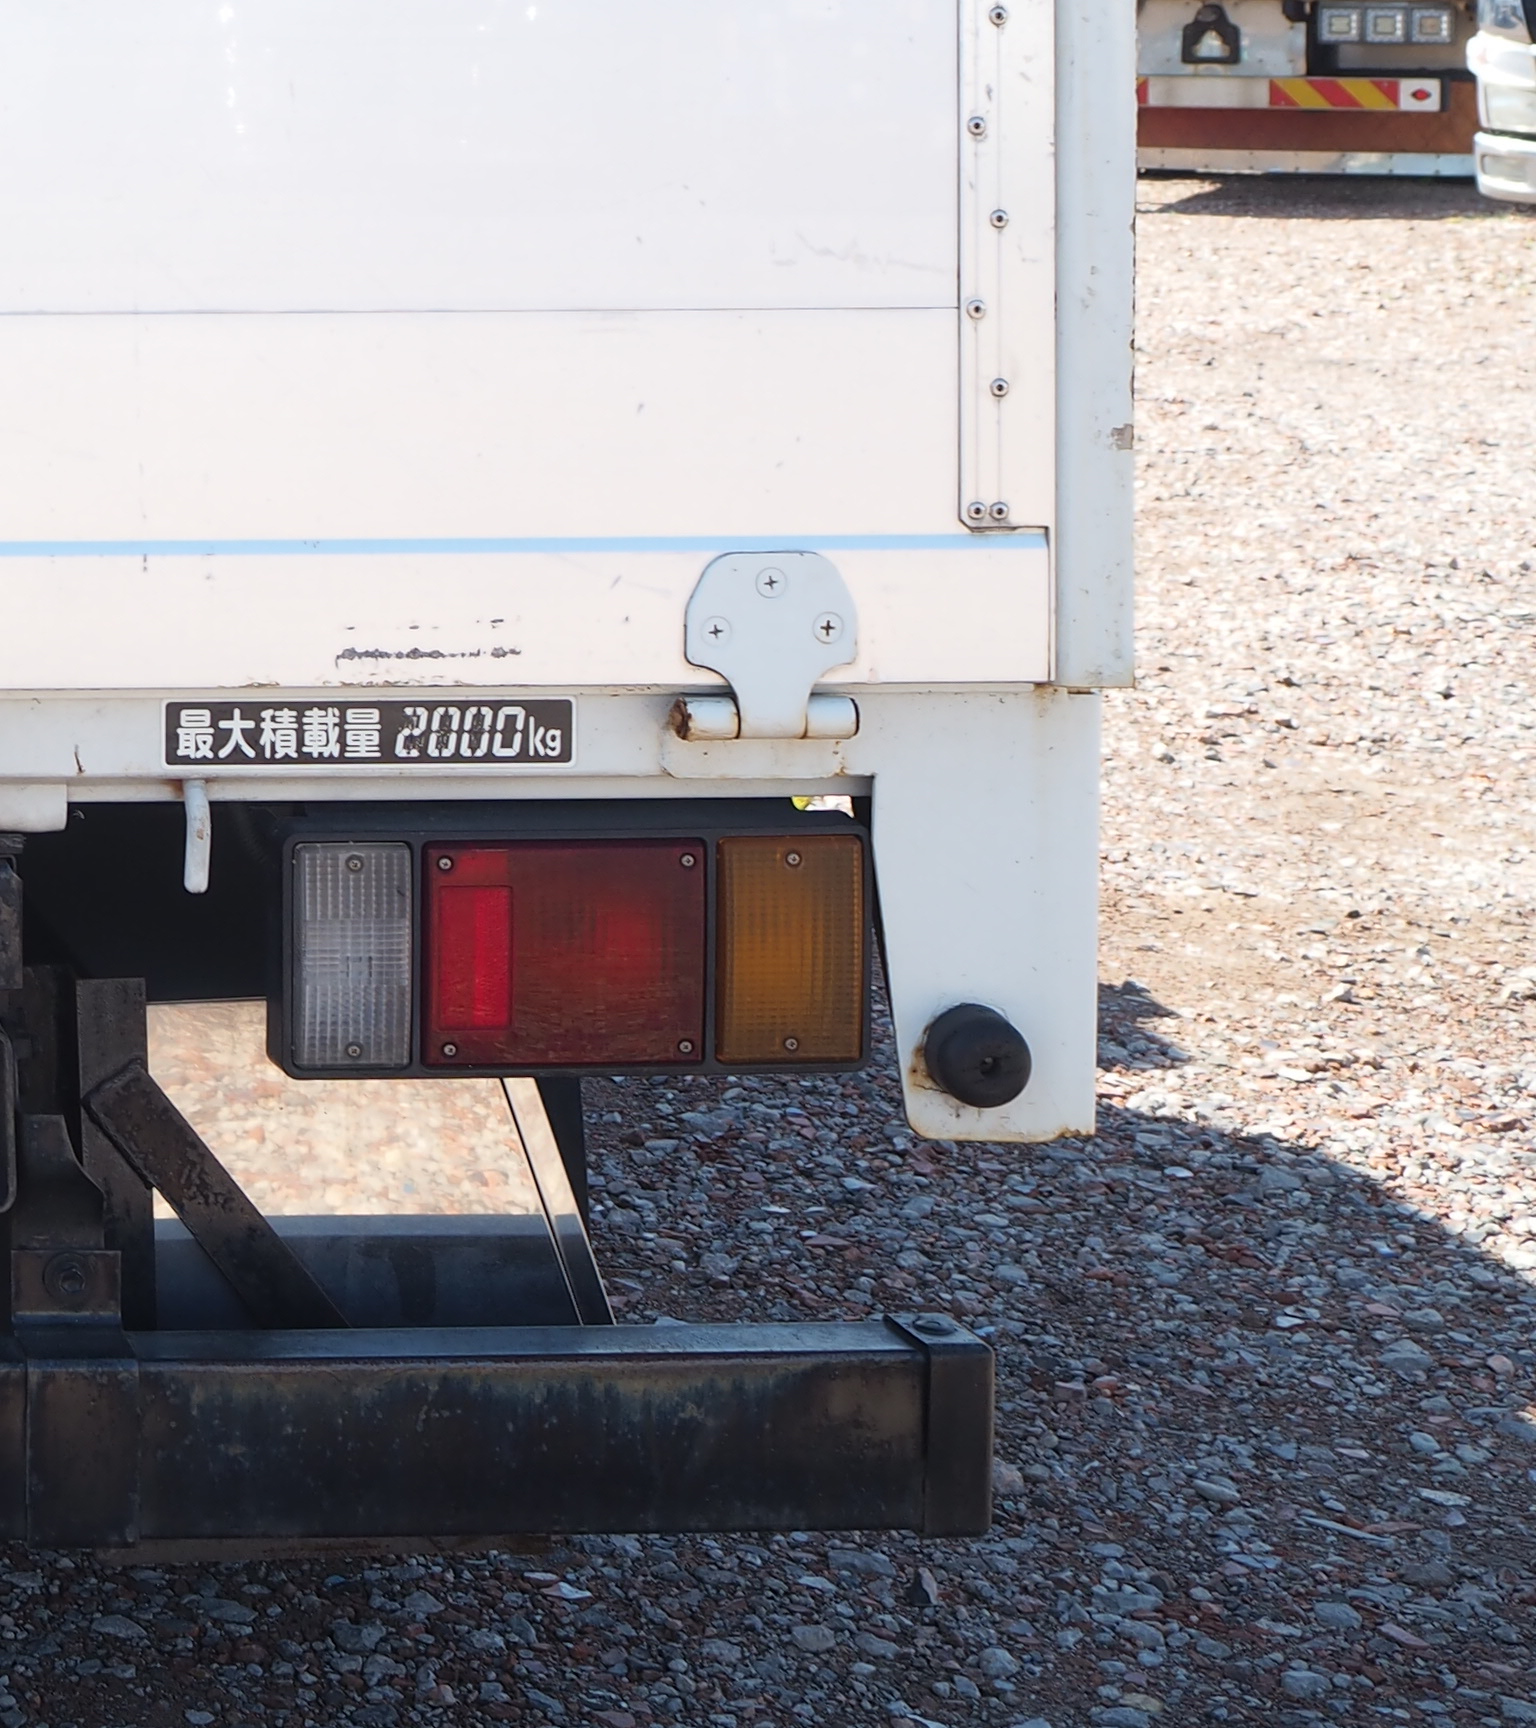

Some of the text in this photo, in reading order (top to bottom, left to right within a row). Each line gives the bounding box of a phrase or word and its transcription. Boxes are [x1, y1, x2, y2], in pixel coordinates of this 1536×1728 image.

[176, 707, 383, 760] 最大積載量
